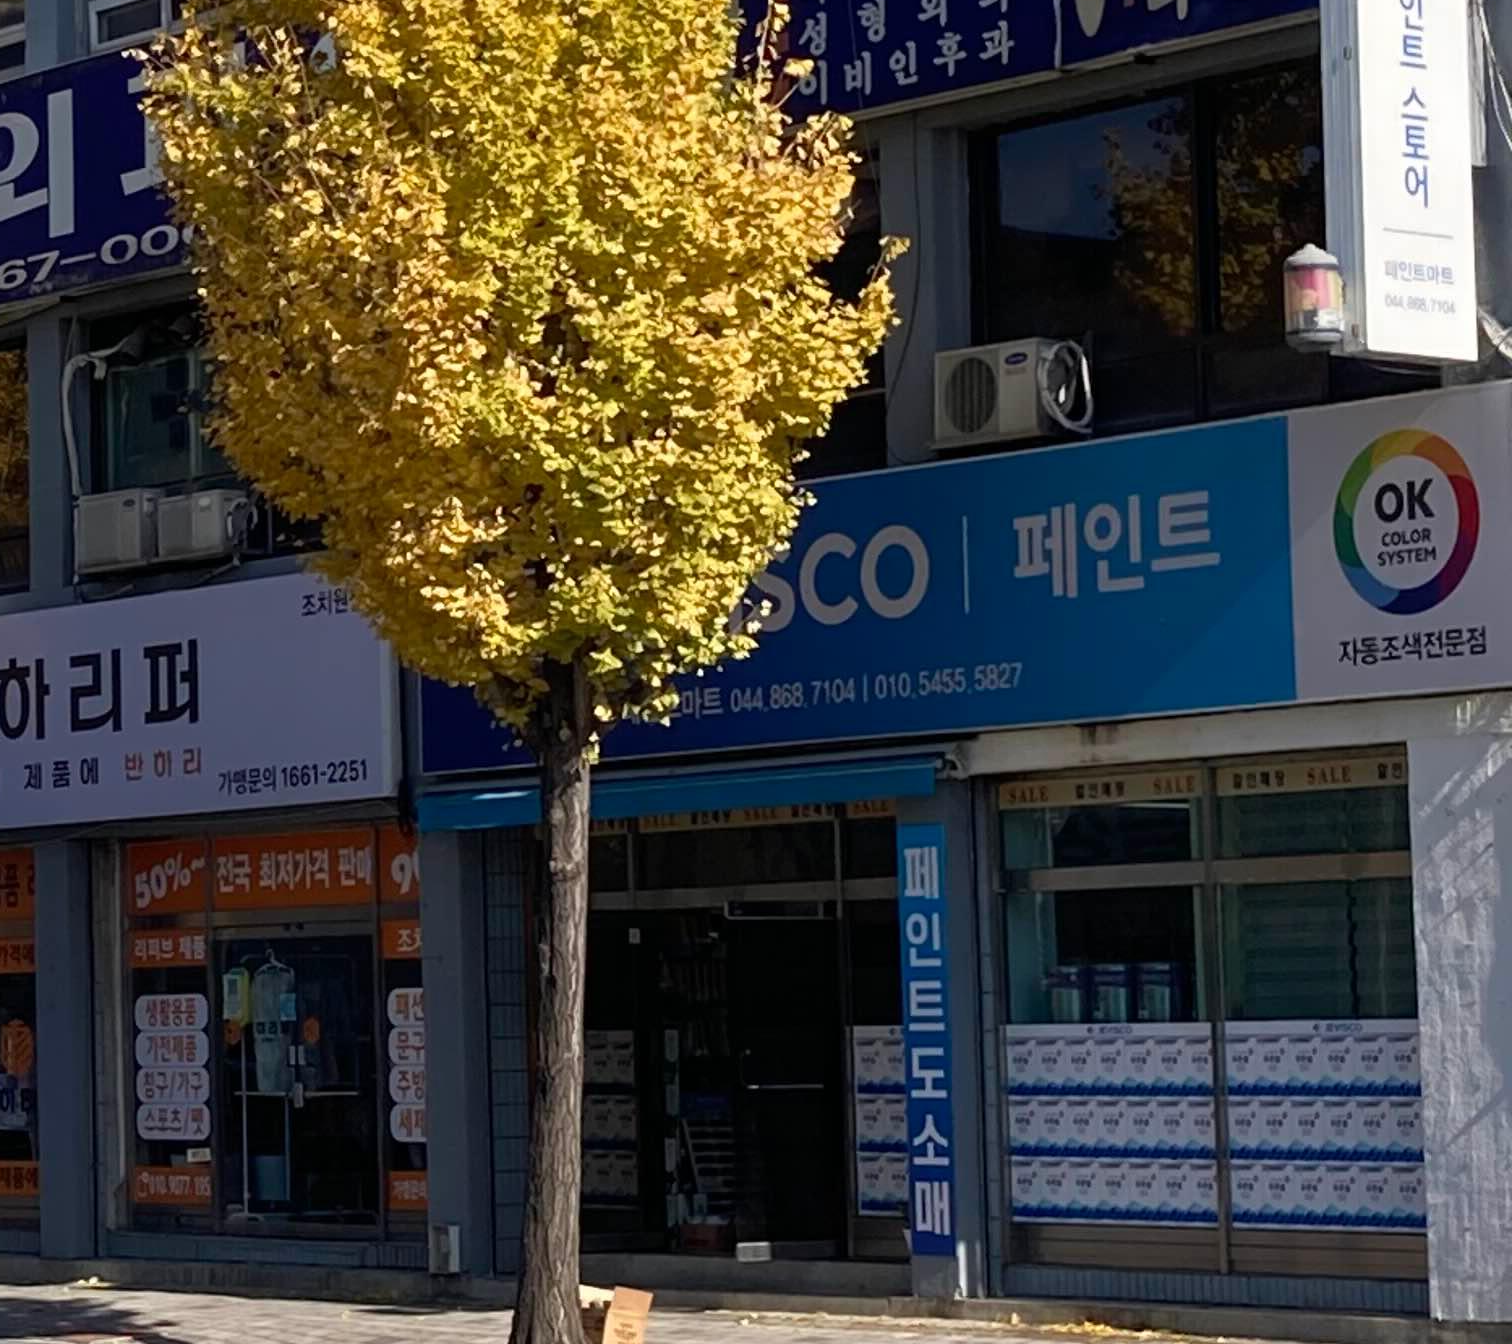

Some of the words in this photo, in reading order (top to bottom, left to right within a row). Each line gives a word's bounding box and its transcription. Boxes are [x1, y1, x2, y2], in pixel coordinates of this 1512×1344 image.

[798, 20, 1016, 106] 이비인후과
[1374, 478, 1435, 523] OK
[1013, 490, 1221, 598] 페인트
[1381, 528, 1432, 547] COLOR
[1377, 547, 1437, 567] SYSTEM
[300, 587, 355, 617] 조치원
[1338, 625, 1488, 666] 자동조색전문점
[730, 678, 855, 714] 044.868.7104
[874, 662, 1023, 700] 010.5455.5827
[24, 757, 100, 790] 제품에
[281, 758, 368, 788] 1661-2251
[1306, 765, 1353, 786] SALE
[1007, 786, 1049, 804] SALE
[215, 852, 251, 895] 전국
[903, 846, 951, 1237] 페인트도소매
